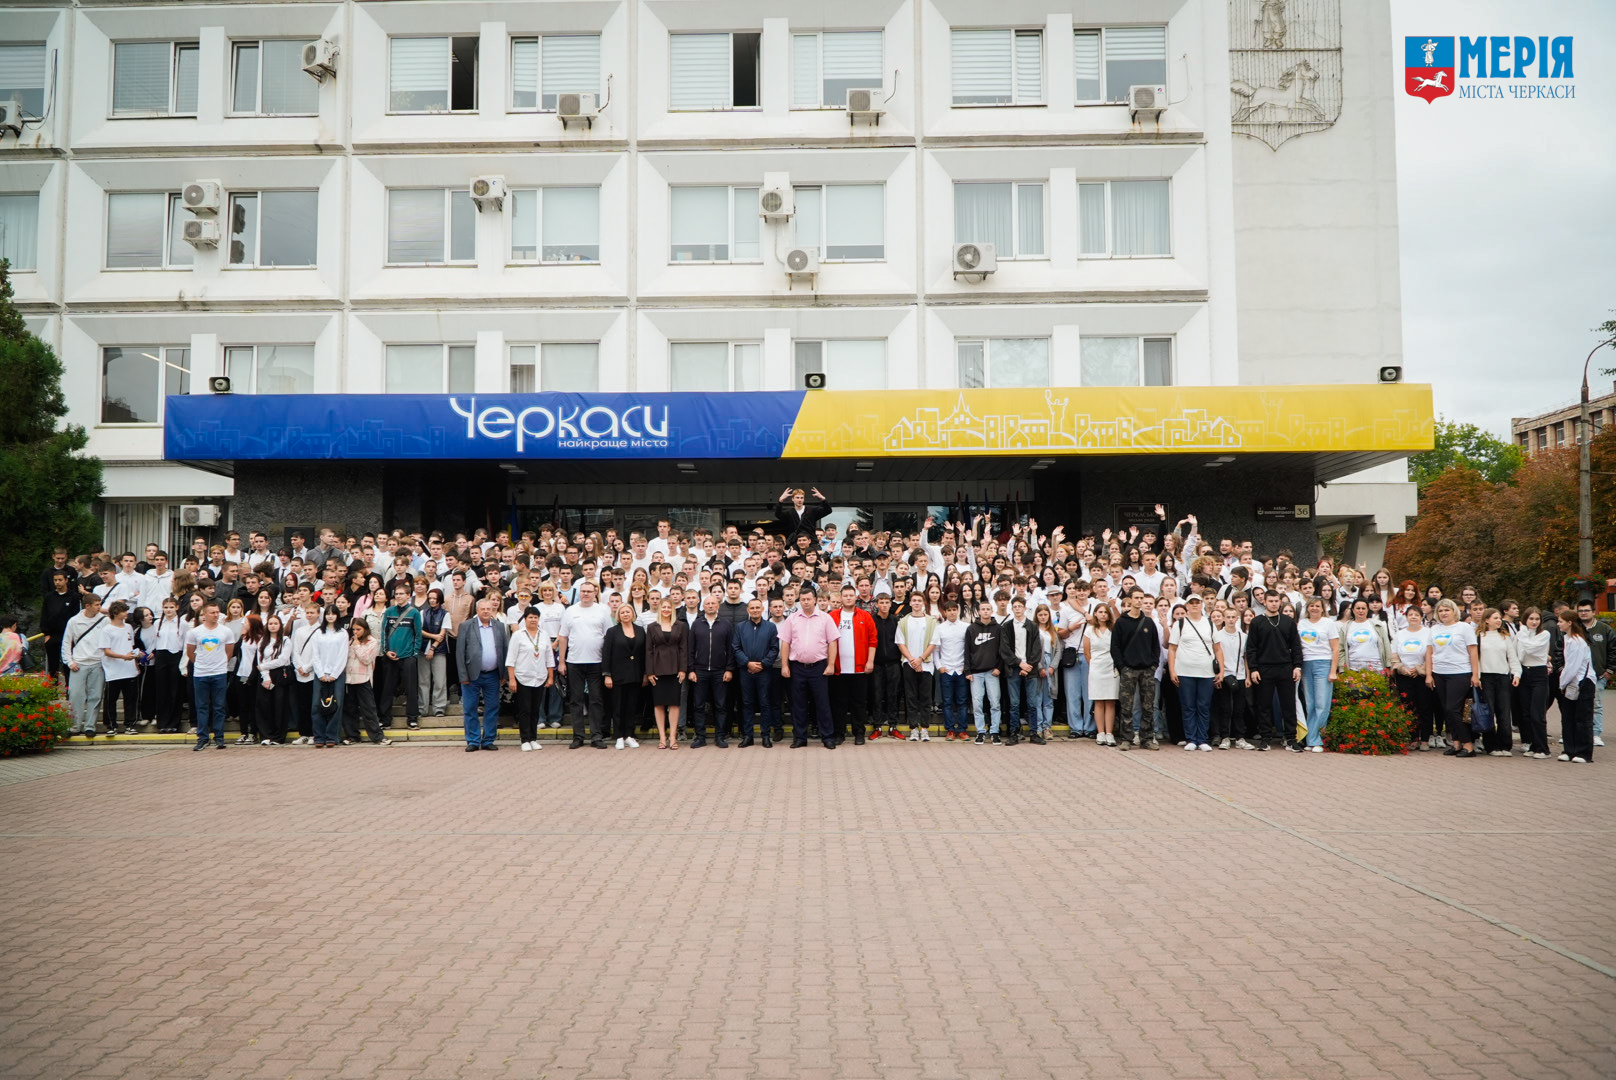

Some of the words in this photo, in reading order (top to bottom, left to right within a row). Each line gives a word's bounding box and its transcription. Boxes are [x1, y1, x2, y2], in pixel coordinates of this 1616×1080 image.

[450, 397, 668, 452] Черкаси
[558, 438, 628, 449] найкраще
[631, 438, 668, 448] місто
[1296, 507, 1309, 516] 36
